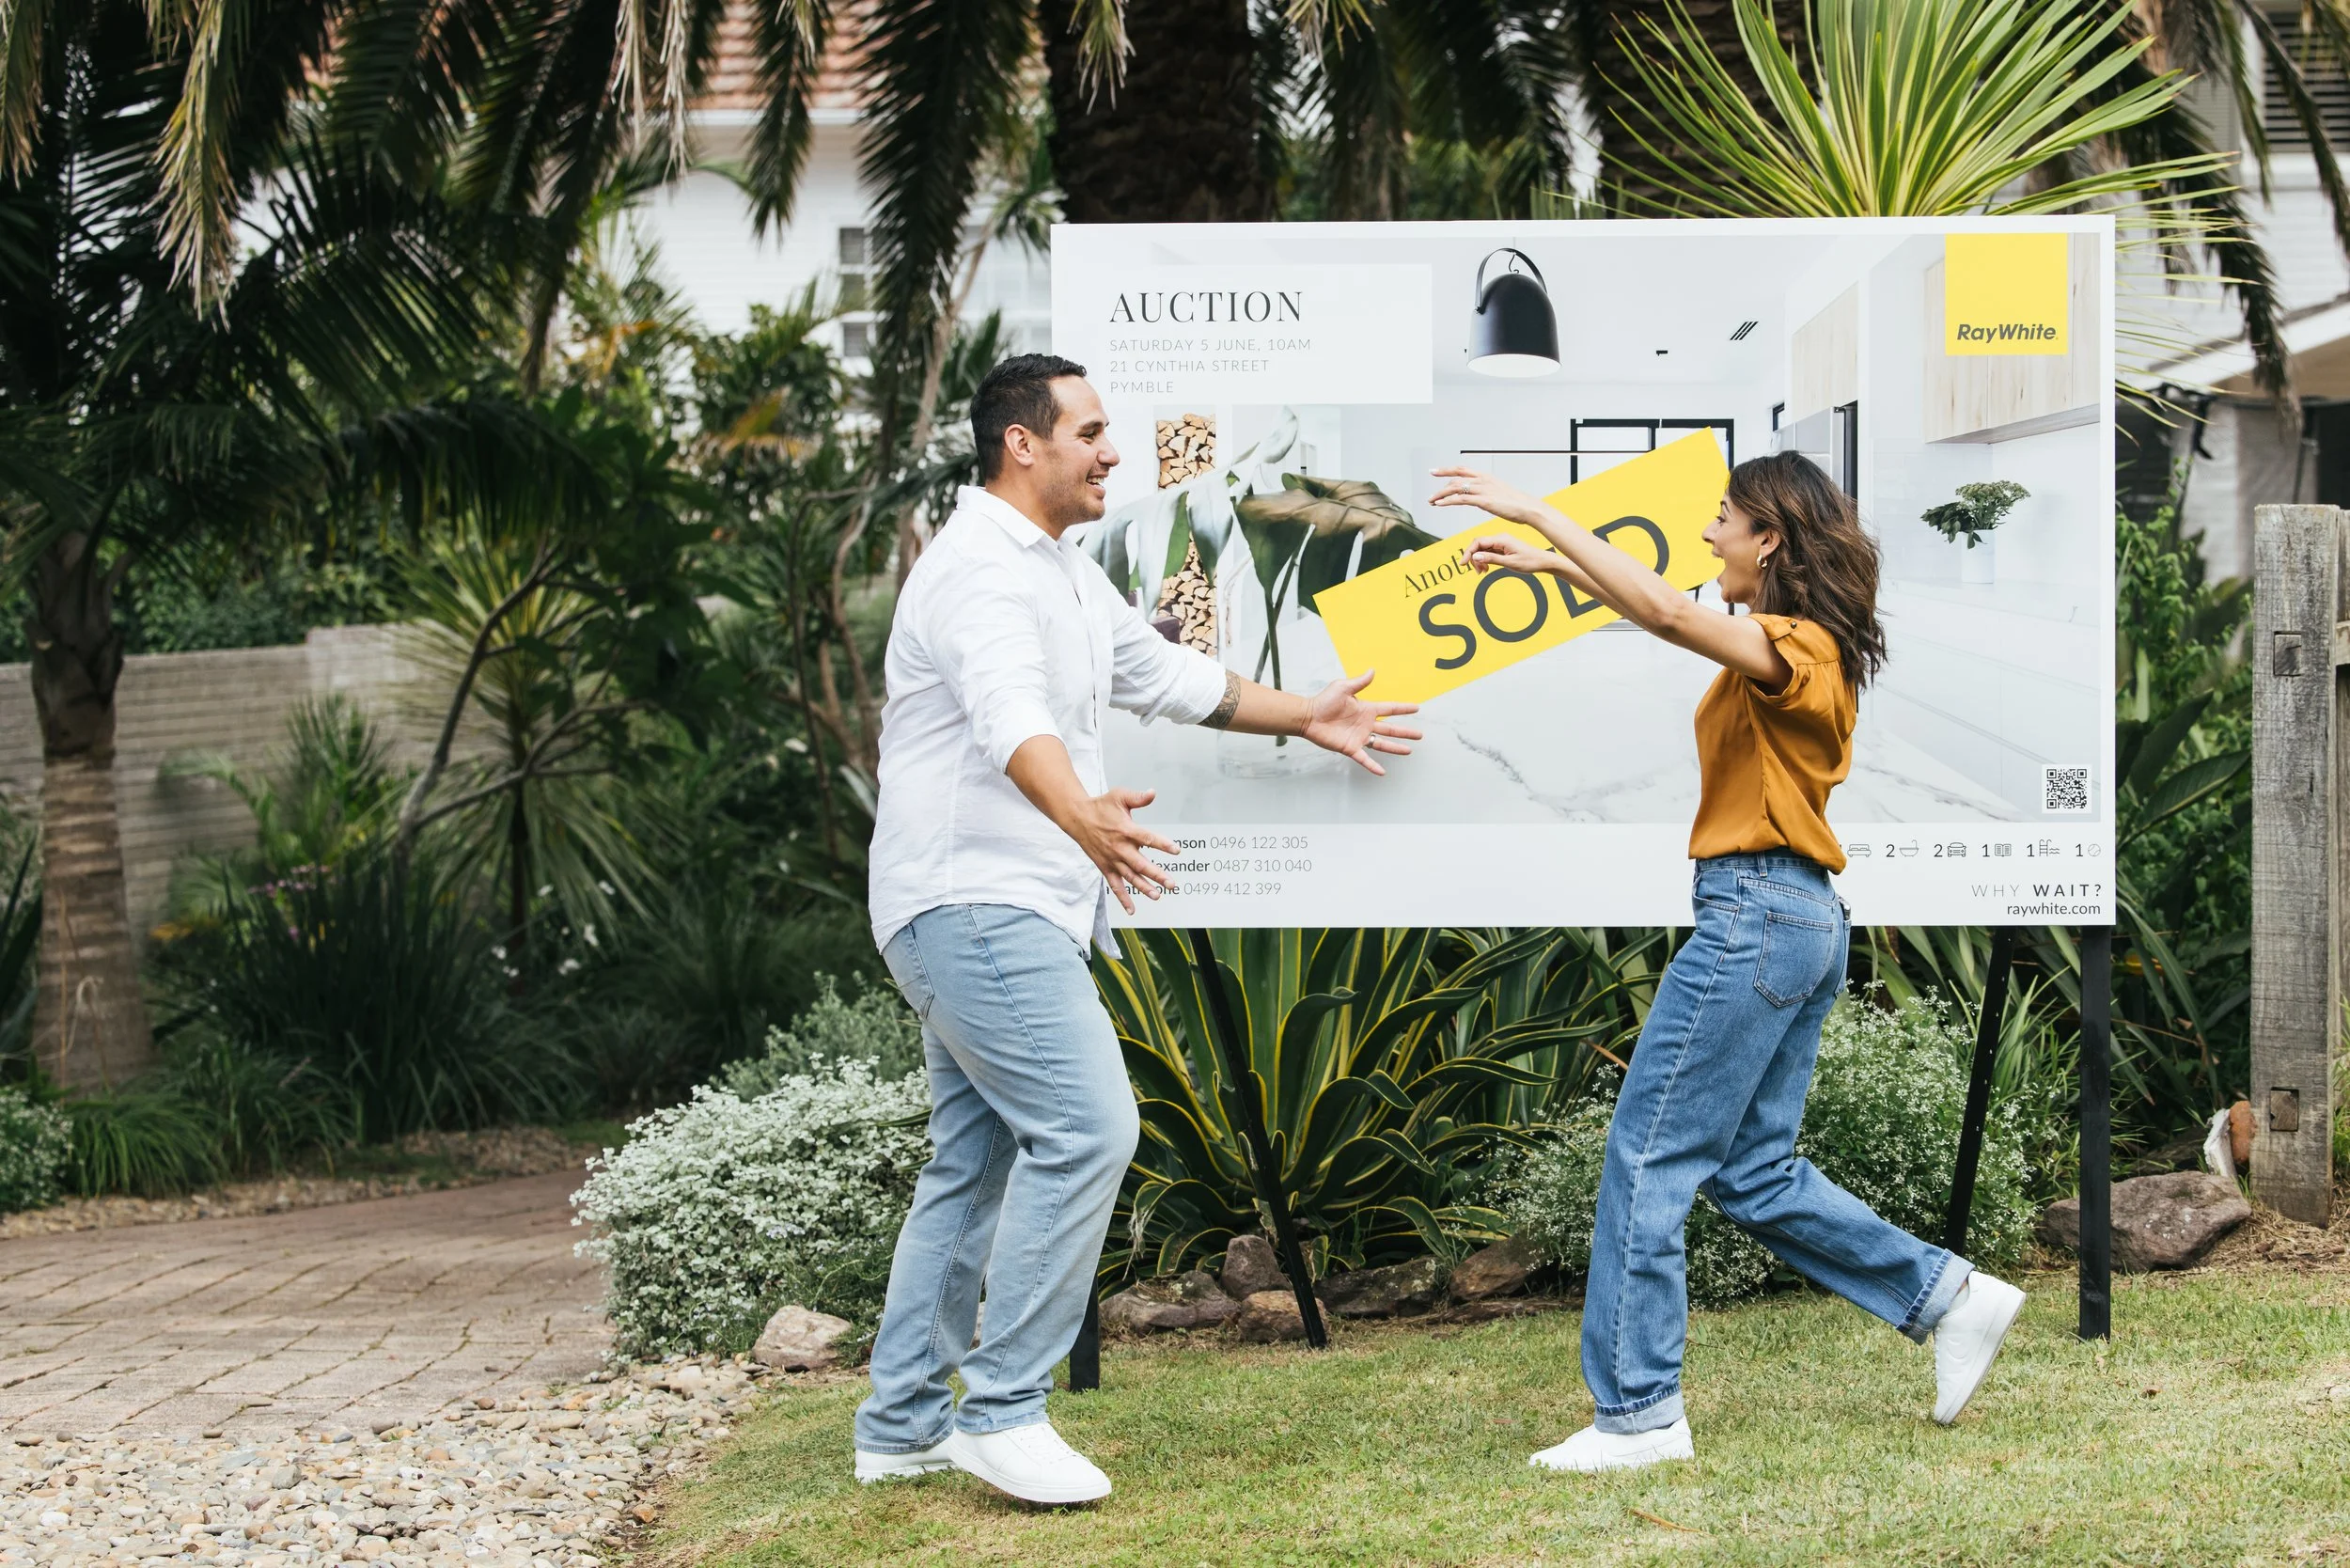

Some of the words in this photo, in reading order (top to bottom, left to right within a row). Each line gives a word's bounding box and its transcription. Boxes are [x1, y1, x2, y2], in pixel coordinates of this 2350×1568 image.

[1109, 291, 1303, 322] AUCTION
[1109, 339, 1194, 352] SATURDAY
[1200, 338, 1209, 352] 5
[1215, 338, 1261, 353] JUNE,
[1268, 338, 1310, 351] 10AM
[1110, 360, 1127, 372] 21
[1135, 360, 1205, 372] CYNTHIA
[1212, 359, 1269, 372] STREET
[1110, 381, 1174, 394] PYMBLE
[1404, 548, 1473, 598] Anot
[1210, 837, 1246, 849] 0496
[1251, 837, 1277, 849] 122
[1281, 837, 1308, 849] 305
[1886, 843, 1895, 857] 2
[1934, 843, 1943, 857] 2
[1982, 844, 1991, 857] 1
[2027, 844, 2035, 857] 1
[2076, 844, 2084, 857] 1
[1214, 859, 1249, 872] 0487
[1254, 859, 1280, 872] 310
[1285, 859, 1312, 872] 040
[1183, 883, 1219, 895] 0499
[1224, 883, 1250, 895] 412
[1255, 883, 1281, 895] 399
[1971, 884, 2020, 897] WHY
[2032, 884, 2102, 897] WAIT?
[2007, 902, 2101, 917] raywhite.com
